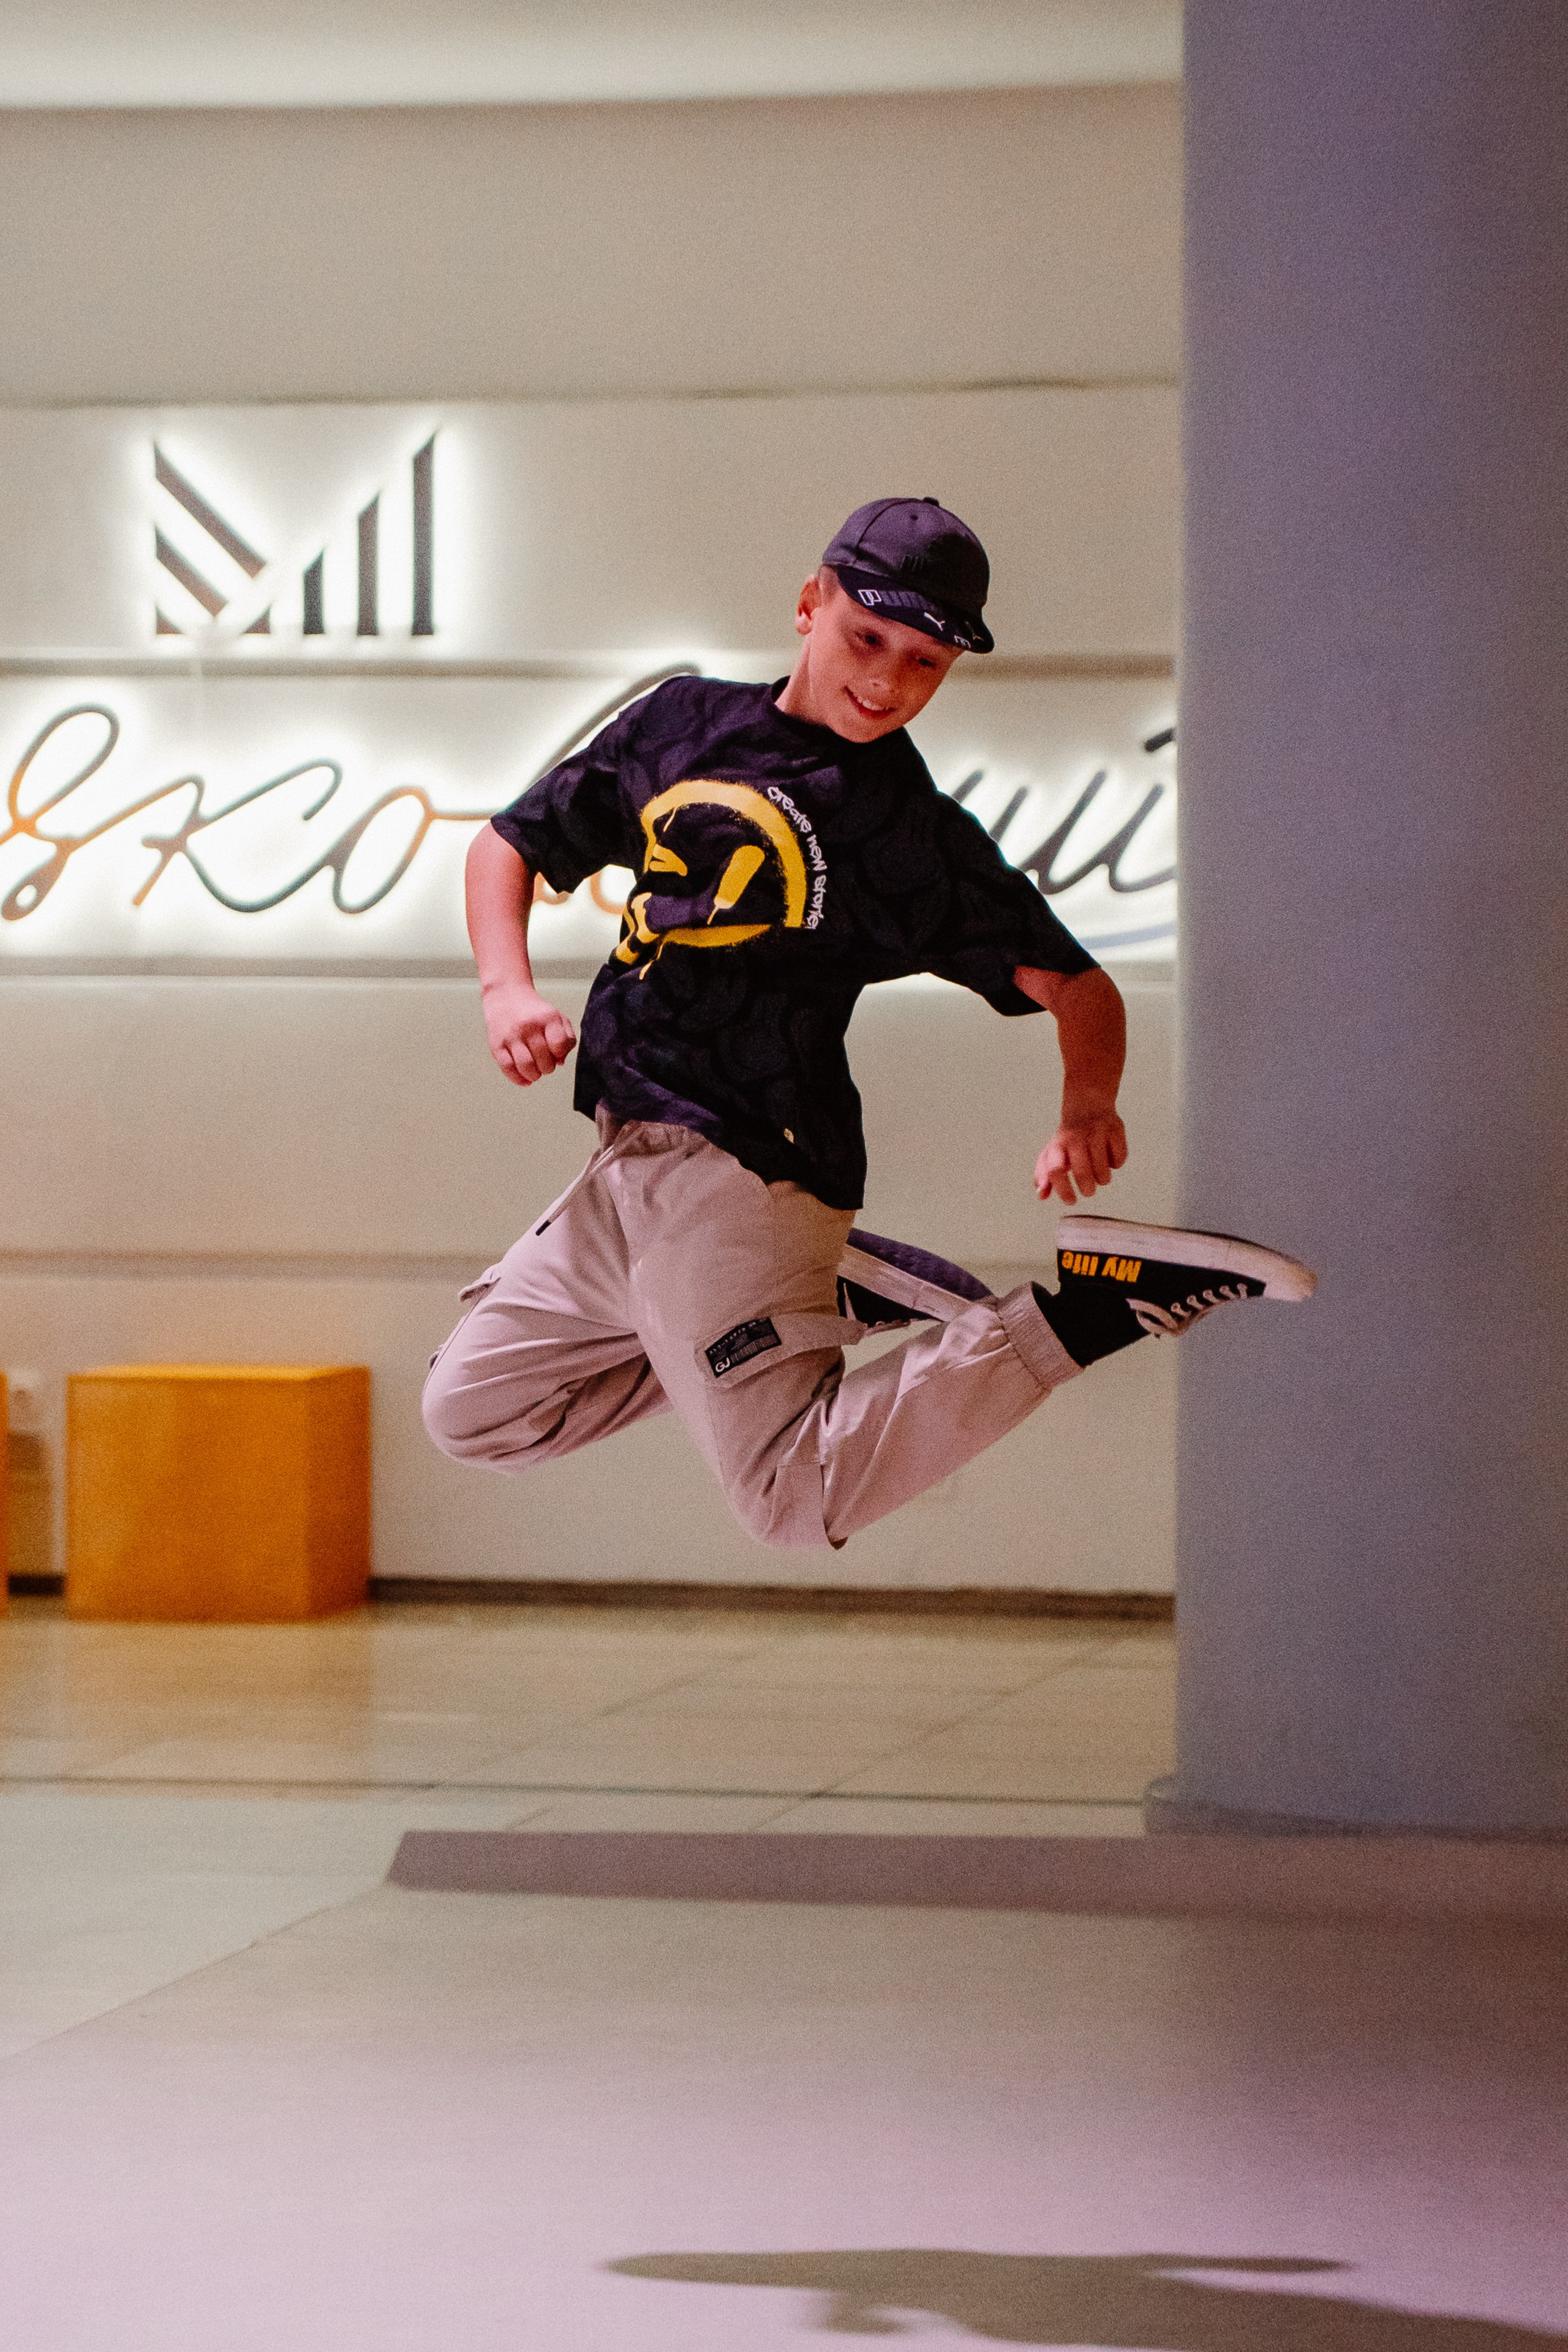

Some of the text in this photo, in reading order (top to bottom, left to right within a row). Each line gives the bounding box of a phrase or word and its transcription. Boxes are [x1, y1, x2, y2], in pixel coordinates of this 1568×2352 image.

[805, 874, 827, 930] storie
[1061, 1251, 1142, 1283] My life
